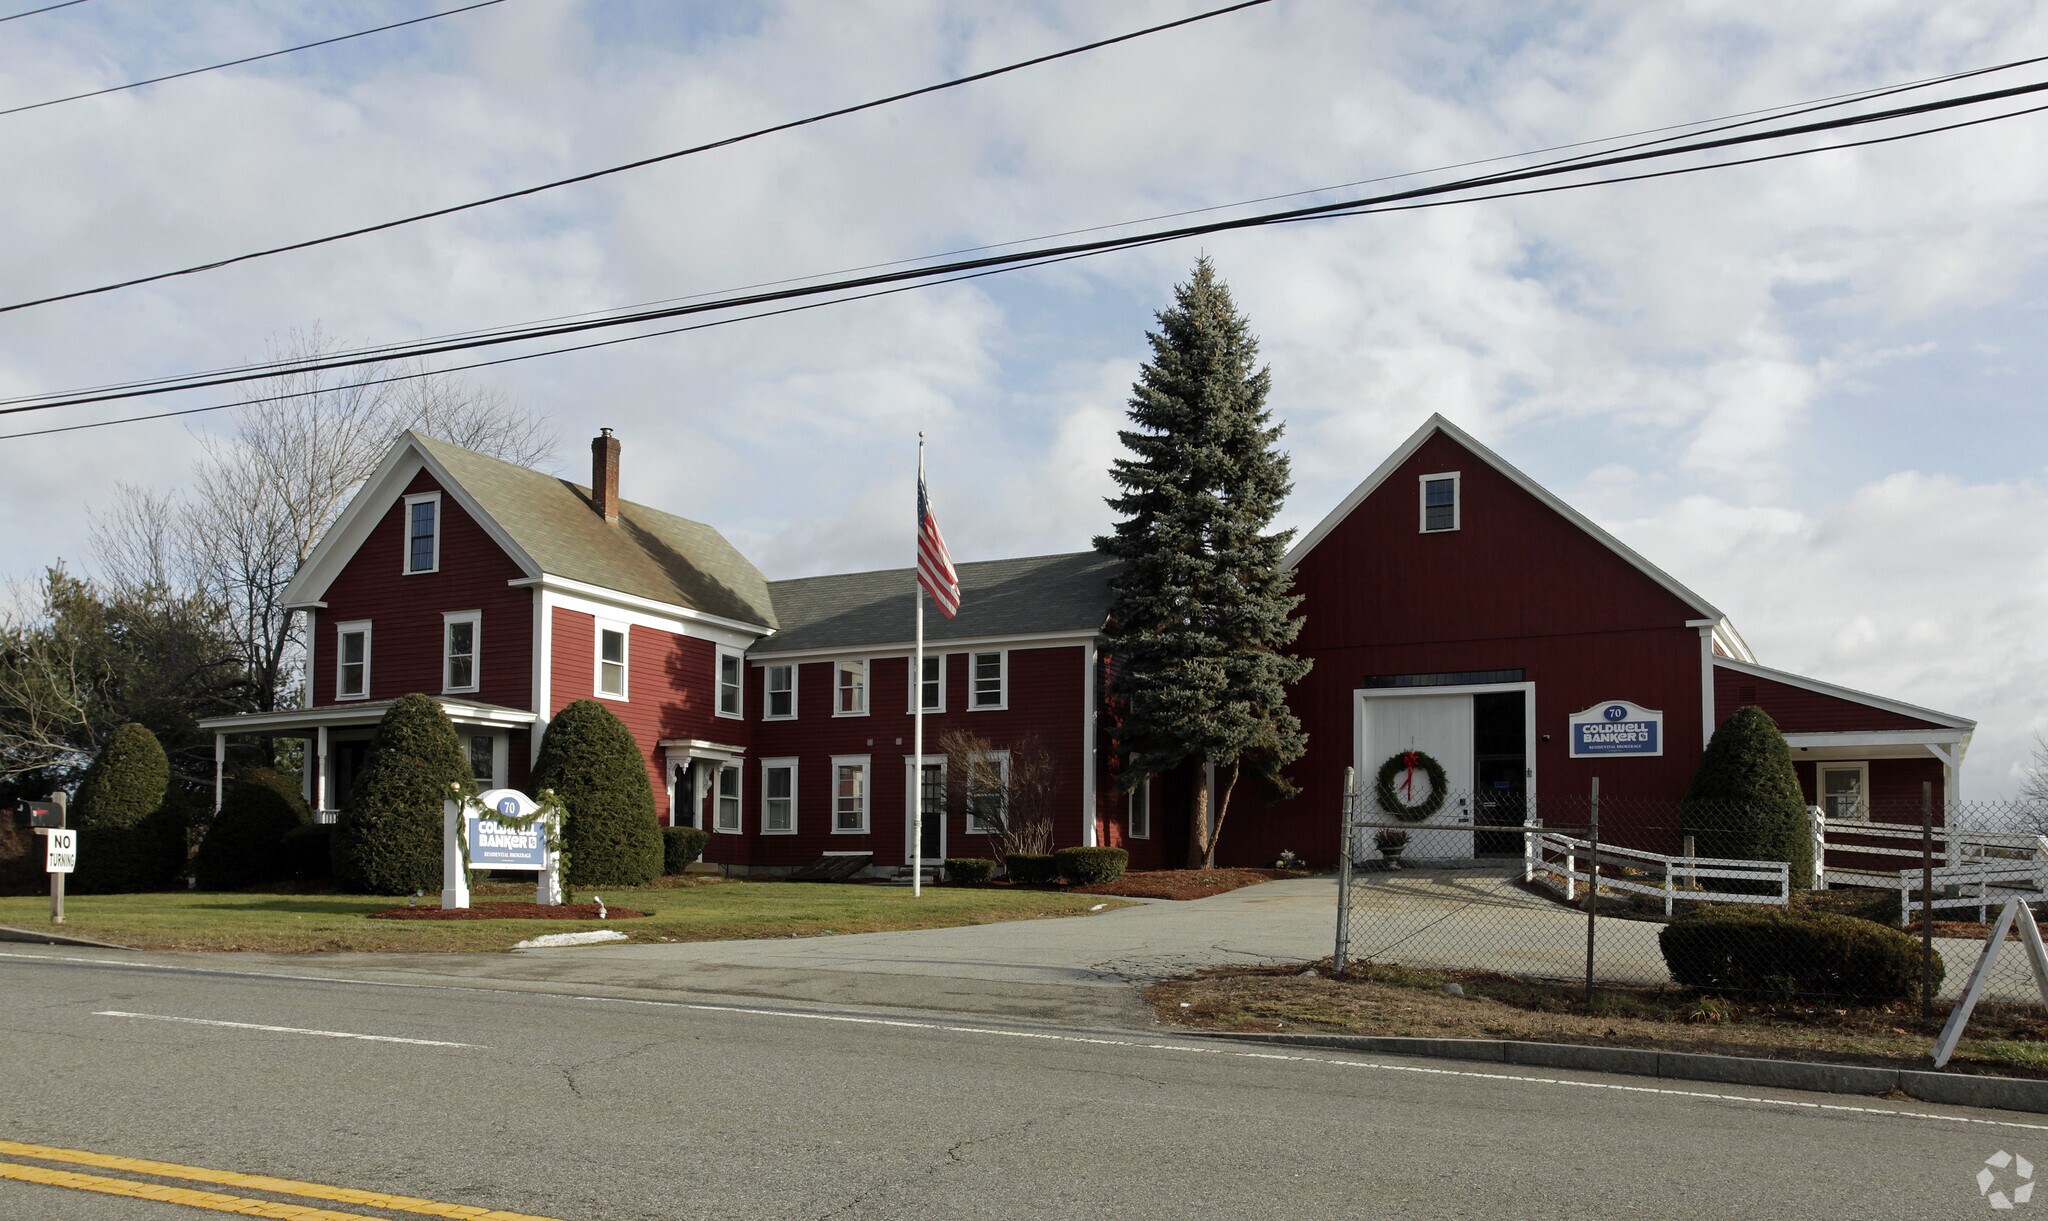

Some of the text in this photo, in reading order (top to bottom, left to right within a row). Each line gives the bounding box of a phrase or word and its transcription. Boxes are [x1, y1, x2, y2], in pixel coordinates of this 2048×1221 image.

[1609, 708, 1621, 718] 70
[1582, 723, 1649, 734] COLDWELL
[1583, 732, 1637, 743] BANKER
[504, 801, 515, 814] 70
[478, 821, 538, 837] COLDL
[54, 835, 71, 849] NO
[479, 834, 528, 850] BANKER
[49, 853, 75, 868] TURNING
